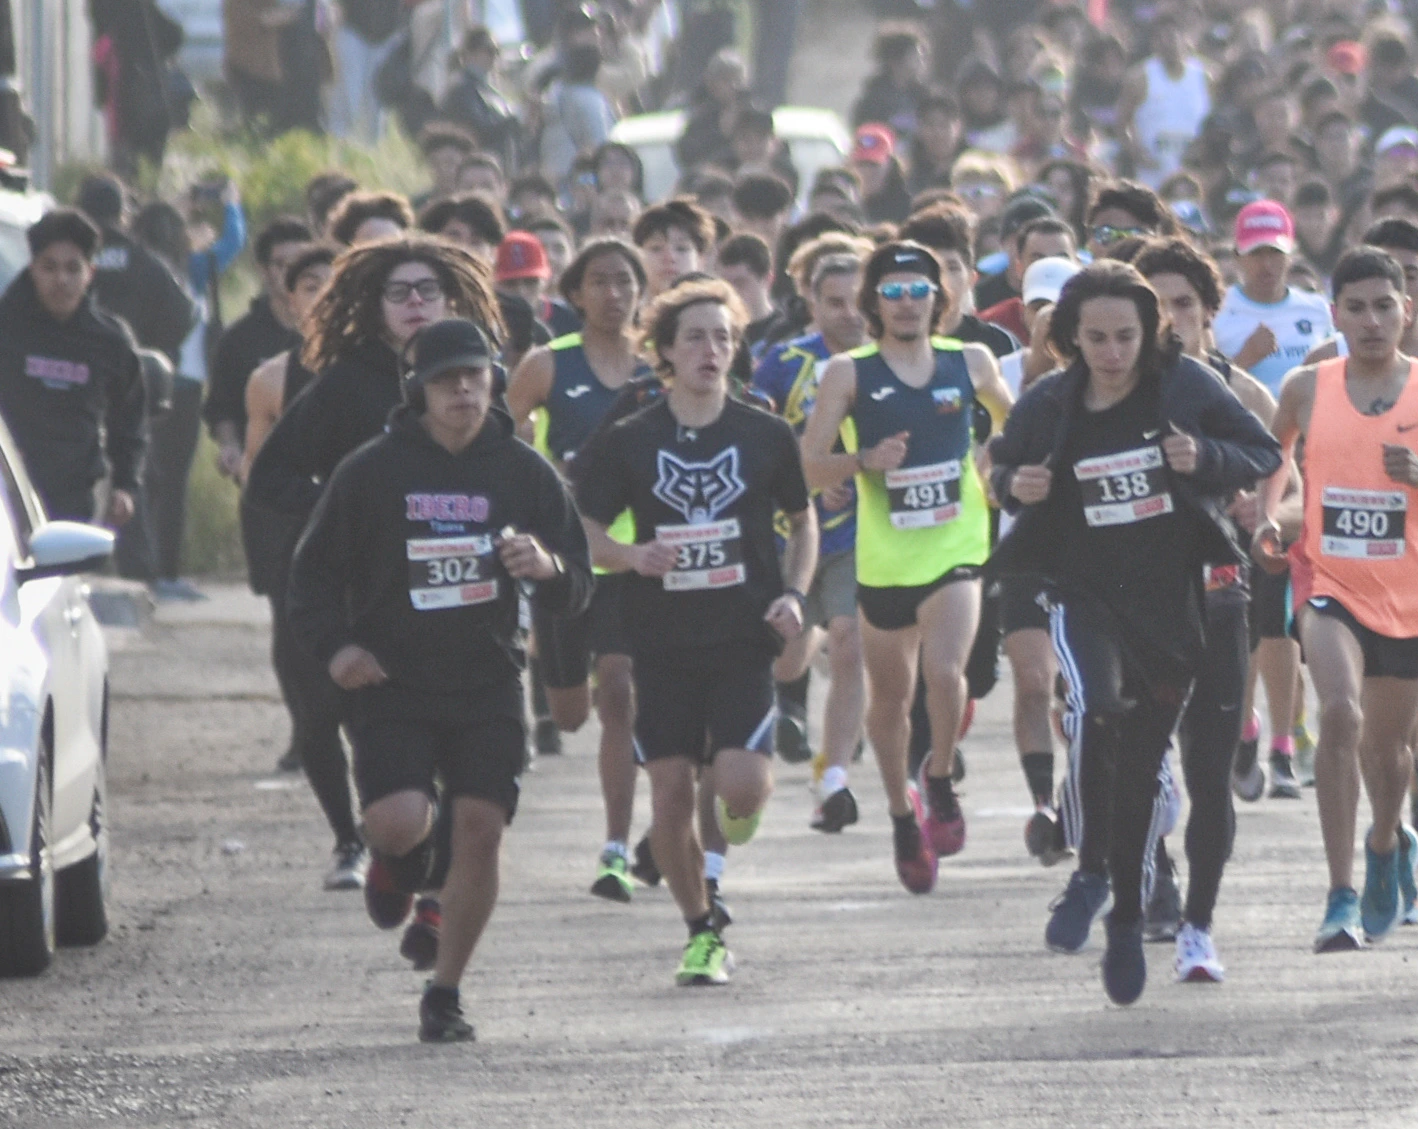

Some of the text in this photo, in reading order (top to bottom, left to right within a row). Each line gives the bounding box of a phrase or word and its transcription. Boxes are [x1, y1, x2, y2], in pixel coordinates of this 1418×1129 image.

[903, 483, 950, 509] 491
[1097, 471, 1151, 503] 138
[405, 494, 489, 523] IBERO
[1335, 509, 1389, 538] 490
[676, 541, 727, 569] 375
[426, 556, 481, 586] 302
